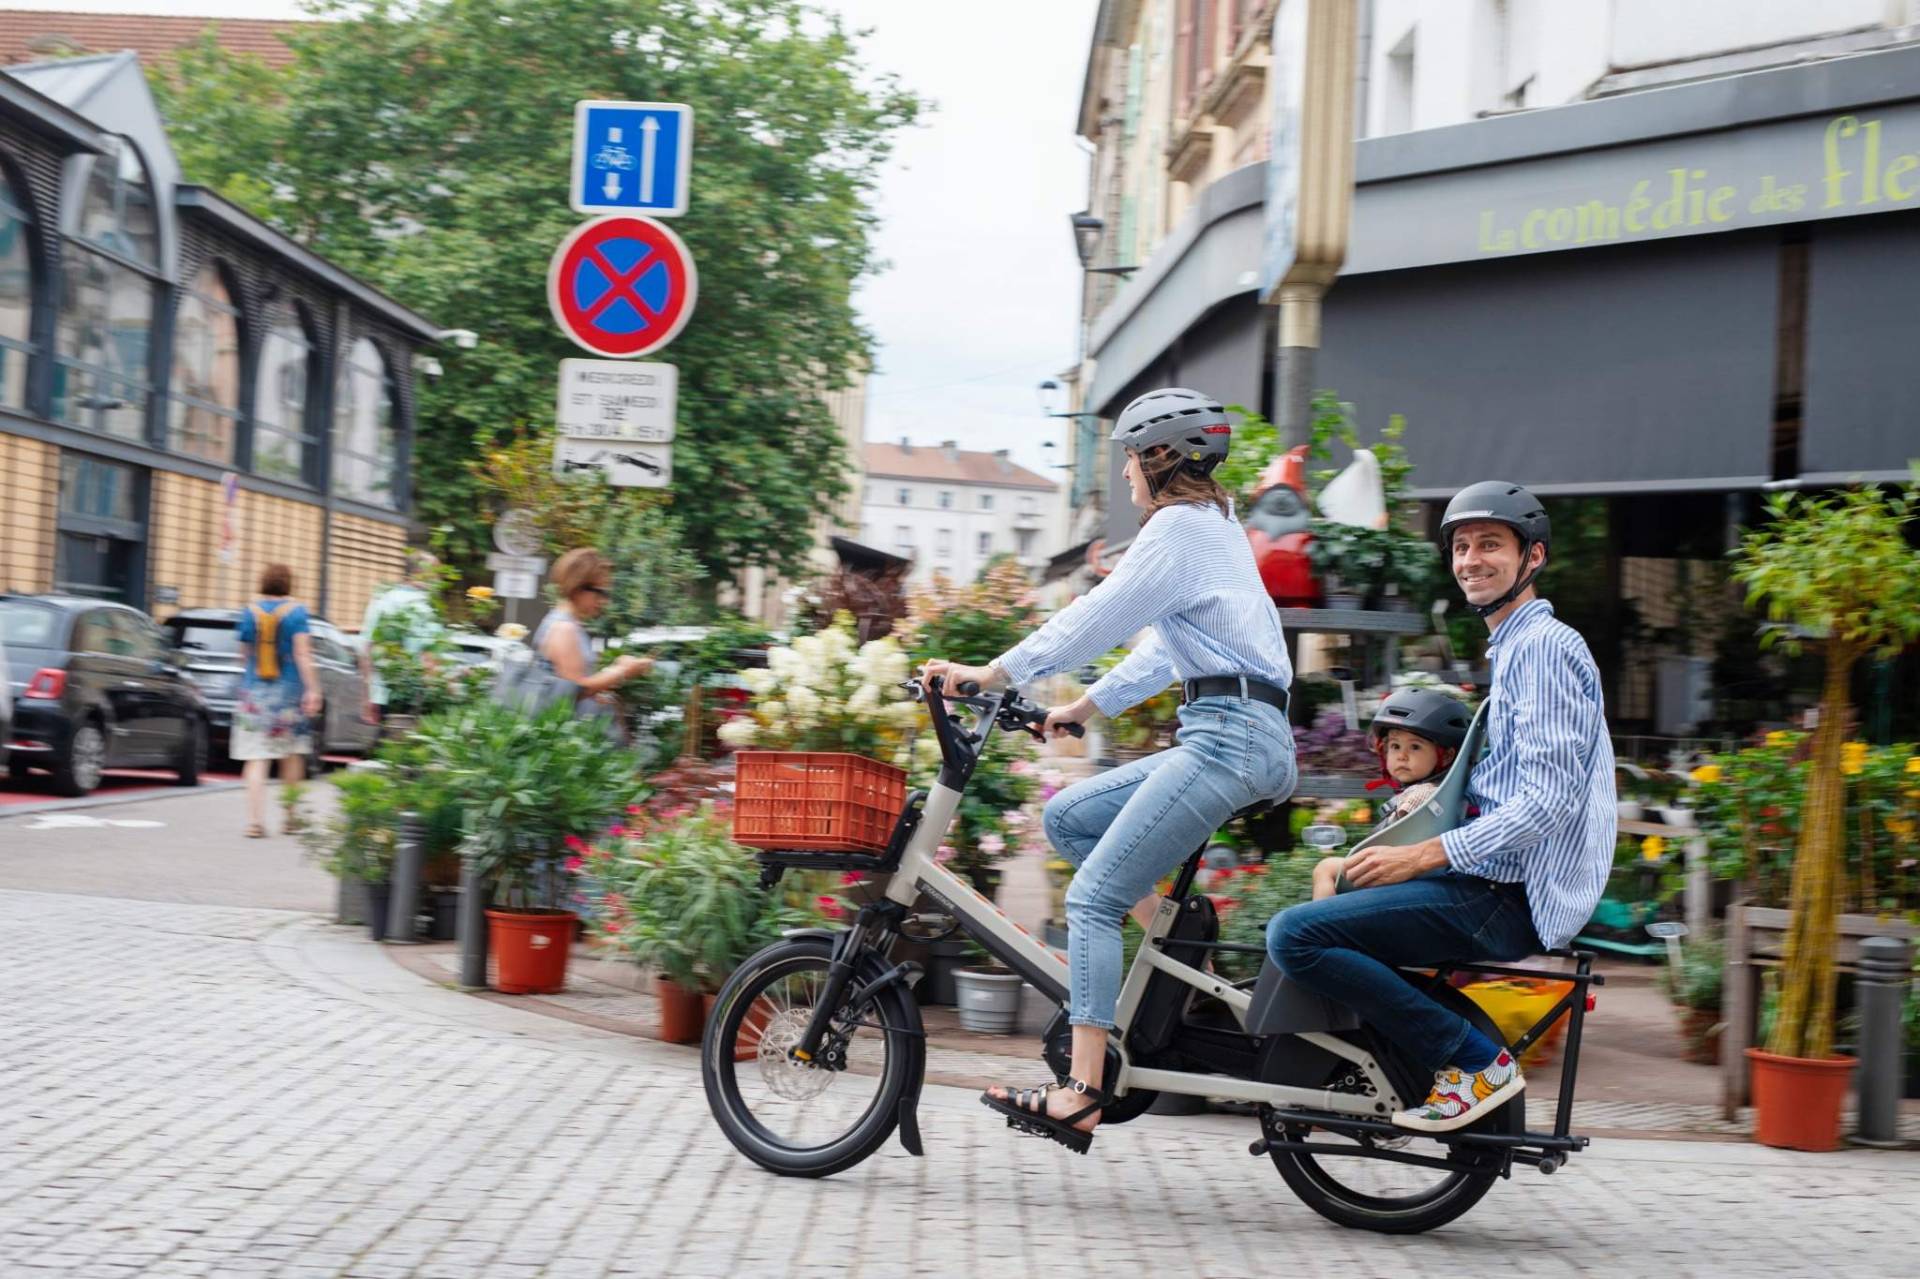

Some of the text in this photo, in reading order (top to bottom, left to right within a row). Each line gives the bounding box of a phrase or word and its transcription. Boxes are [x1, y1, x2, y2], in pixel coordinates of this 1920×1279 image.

[1478, 209, 1516, 252] La
[1521, 168, 1738, 249] comédie
[1749, 175, 1808, 214] des
